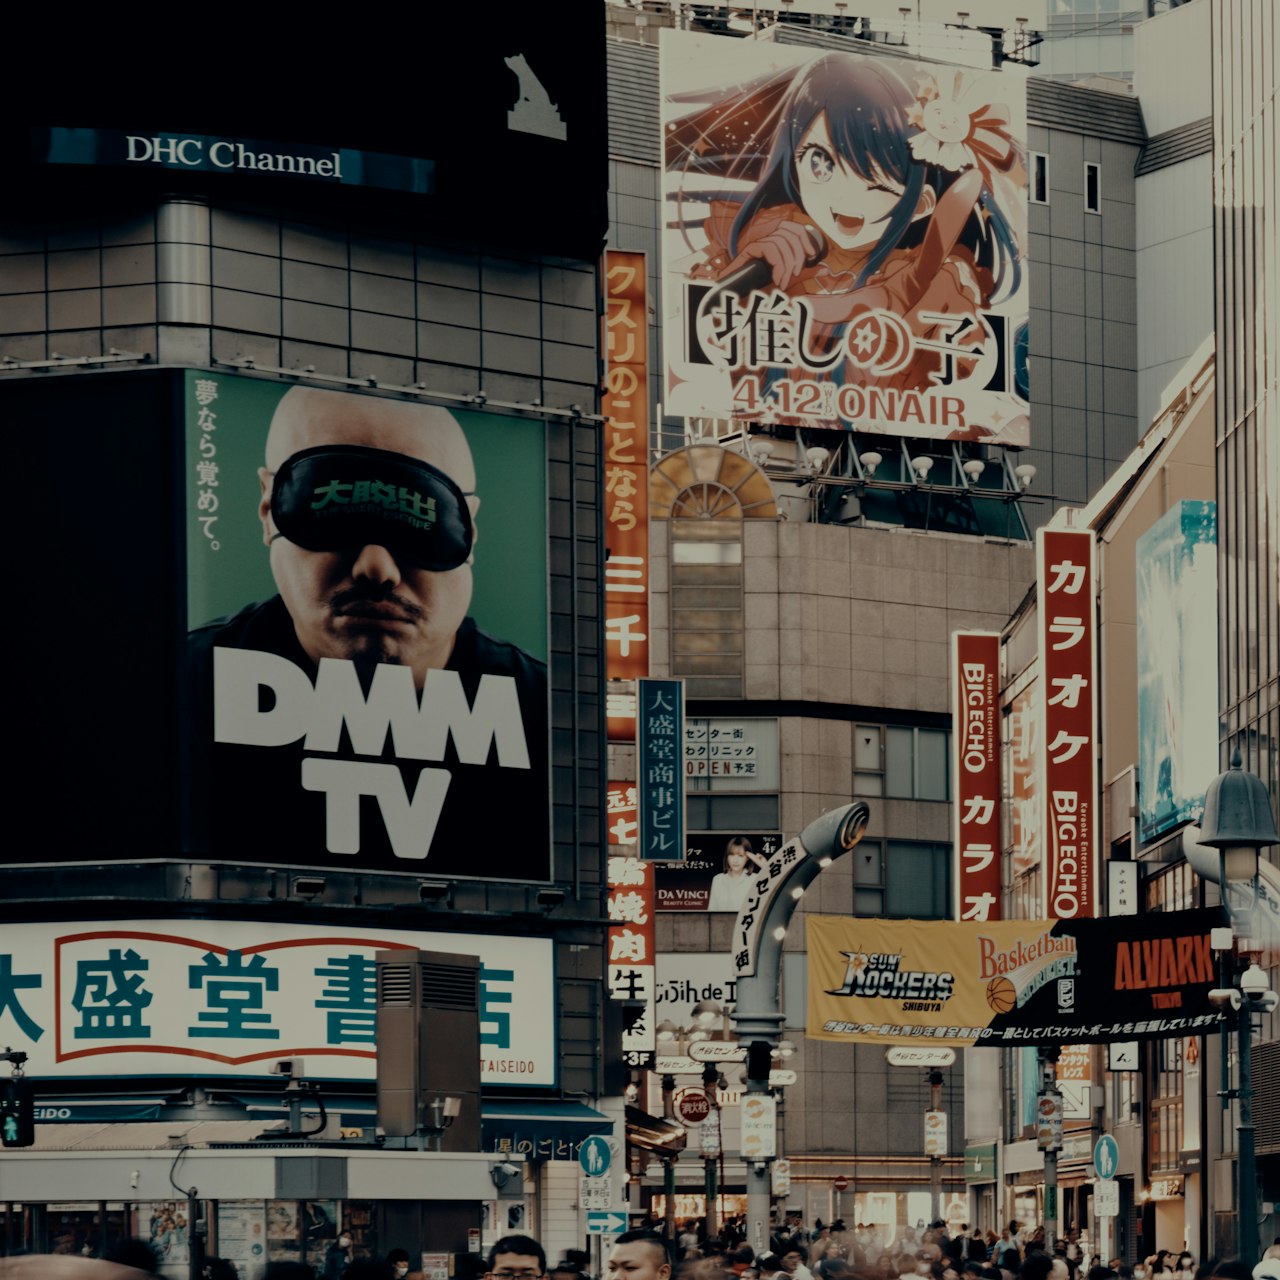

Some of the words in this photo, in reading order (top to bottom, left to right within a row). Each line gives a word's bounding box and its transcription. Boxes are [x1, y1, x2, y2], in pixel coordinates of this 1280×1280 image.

[126, 135, 203, 166] DHC
[208, 141, 343, 178] Channel
[606, 266, 639, 532] クスリのことなら
[194, 379, 222, 552] 夢なら覚めて。
[310, 479, 437, 523] 大脱出
[962, 662, 986, 707] BIG
[986, 673, 994, 705] Karaoke
[1047, 559, 1090, 765] カラオケ
[213, 645, 532, 769] DMM
[987, 707, 995, 762] Entertainment
[963, 709, 987, 774] ECHO
[648, 690, 675, 851] 大盛堂商事ビル
[300, 757, 453, 860] TV
[1051, 790, 1079, 842] BIG
[1080, 801, 1089, 839] Karaoke
[961, 795, 997, 922] カラオ
[1053, 844, 1080, 919] ECHO
[1080, 841, 1089, 906] Entertainment
[658, 890, 675, 899] DA
[676, 889, 709, 899] VINCI
[735, 845, 797, 972] 渋谷センター街
[830, 950, 955, 1001] ROCKERS
[978, 934, 1078, 979] Basketball
[1113, 933, 1216, 991] ALVARK
[902, 1001, 942, 1012] SHIBUYA
[480, 1059, 535, 1074] TAISEIDO
